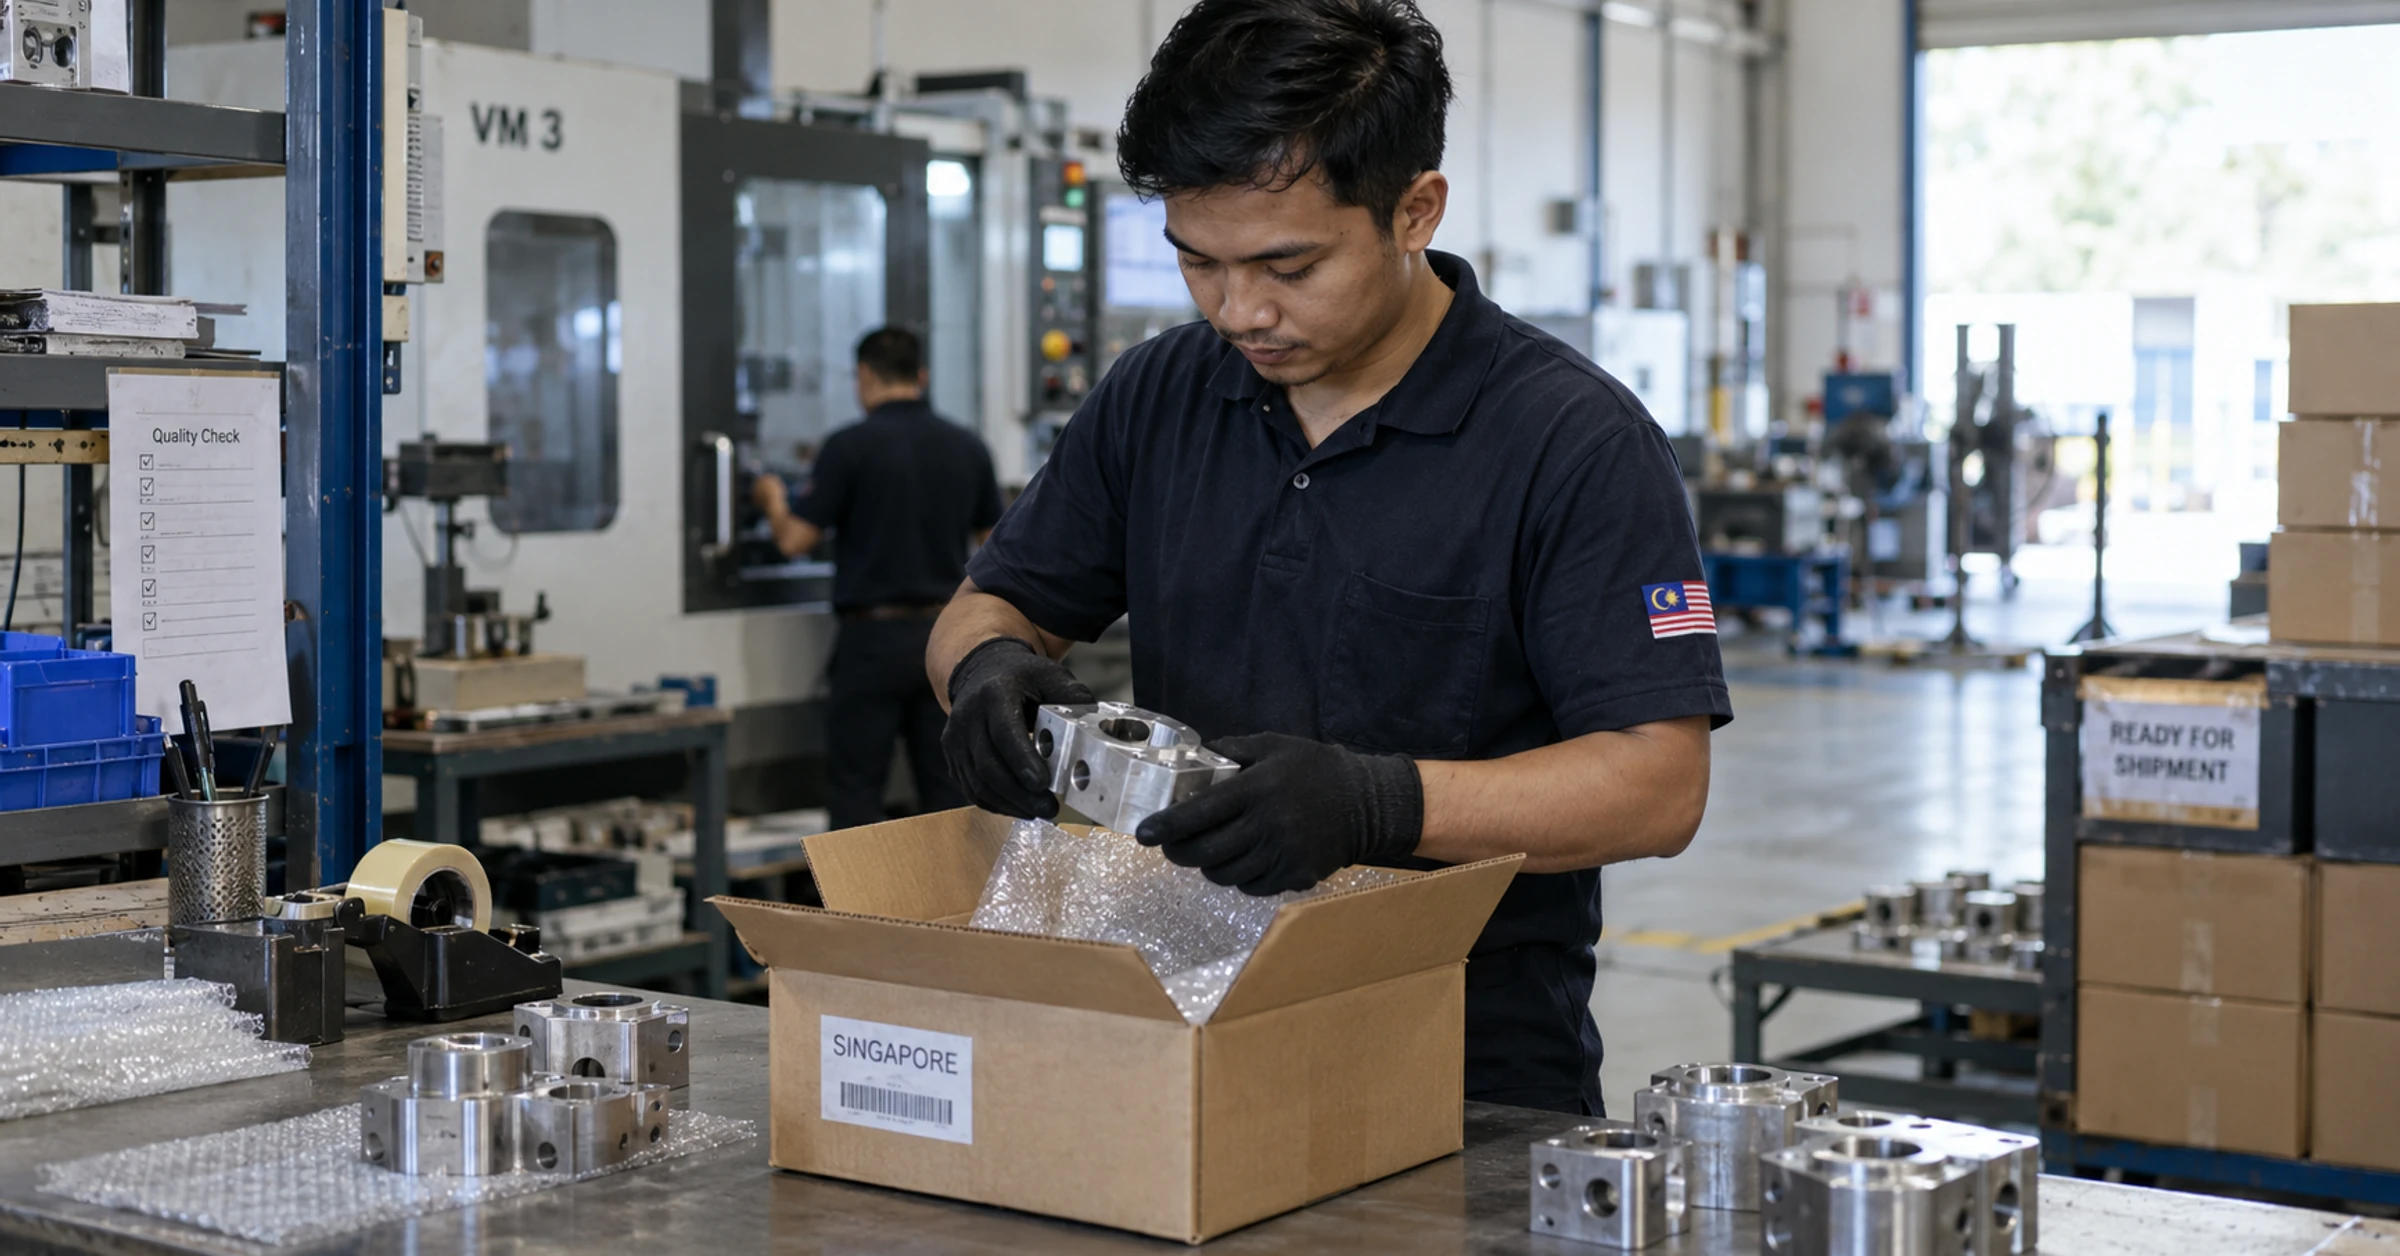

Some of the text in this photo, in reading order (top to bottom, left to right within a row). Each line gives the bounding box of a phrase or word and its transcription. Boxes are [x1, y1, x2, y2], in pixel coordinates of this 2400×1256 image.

[470, 102, 564, 153] VM 3
[152, 427, 240, 447] Quality Check
[2109, 720, 2235, 750] READY FOR
[2114, 754, 2229, 783] SHIPMENT
[833, 1033, 959, 1076] SINGAPORE
